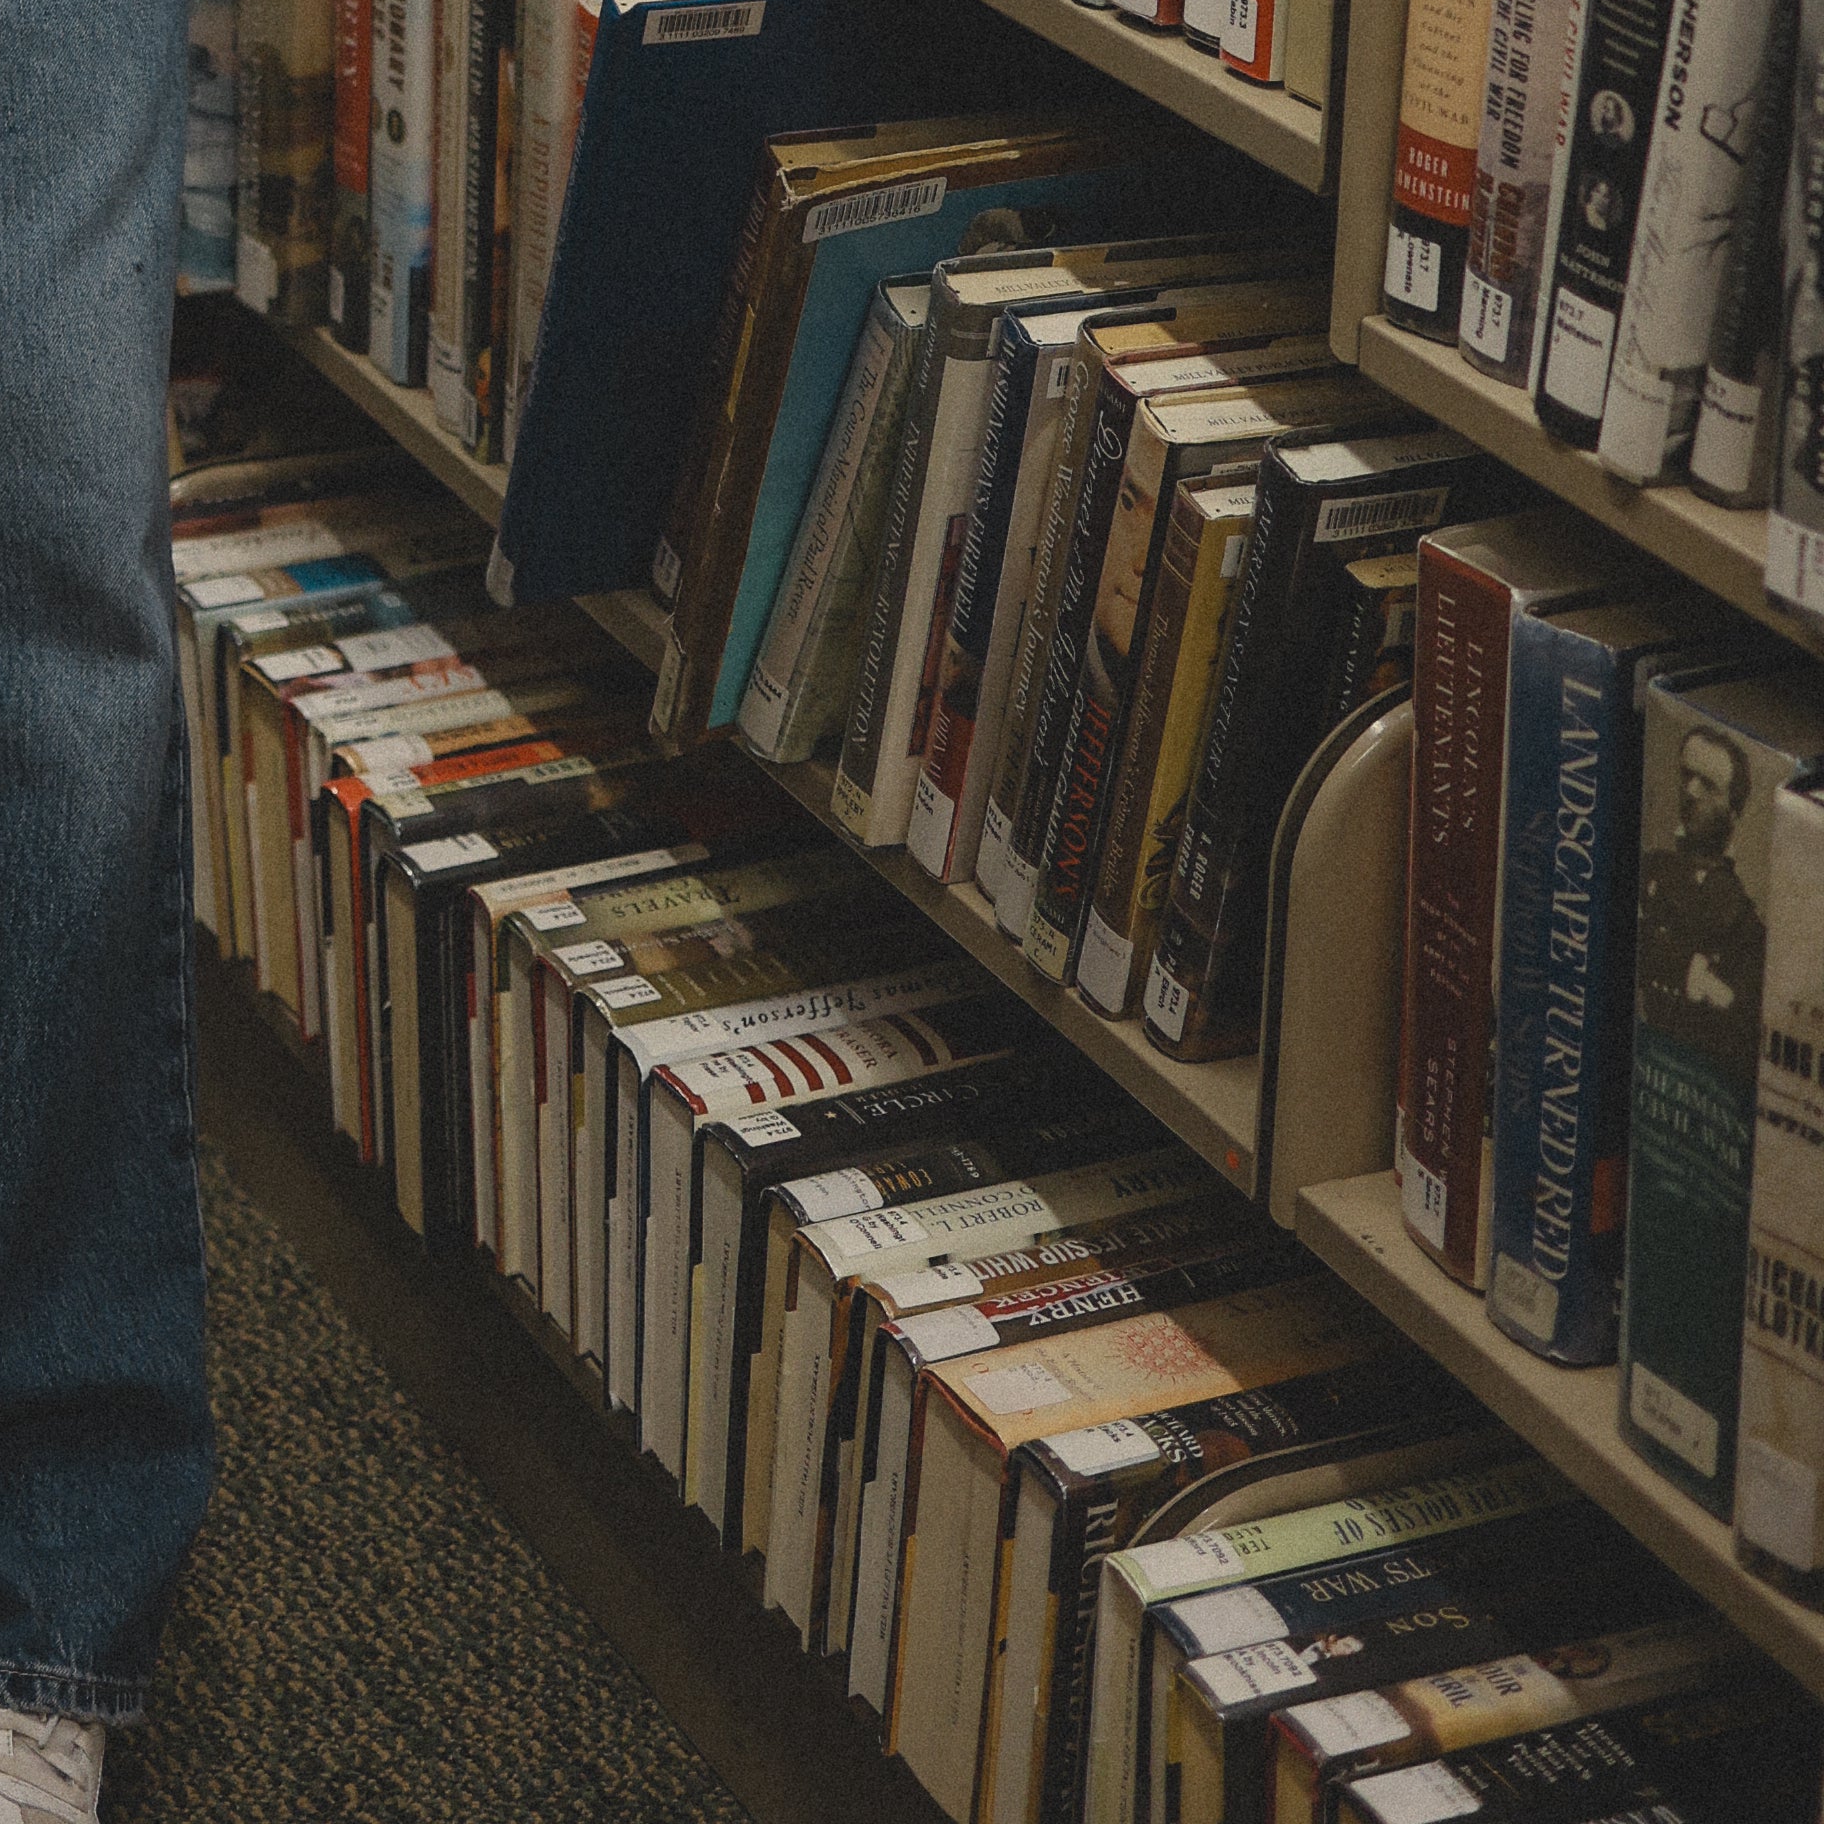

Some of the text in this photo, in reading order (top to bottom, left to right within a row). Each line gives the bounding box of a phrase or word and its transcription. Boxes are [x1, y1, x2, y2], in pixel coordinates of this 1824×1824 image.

[1500, 87, 1530, 169] FREEDOM
[1511, 52, 1534, 83] FOR
[950, 338, 1020, 634] WASHINGTON'S FAREWELL
[1014, 360, 1090, 722] George Washington's Journey
[849, 419, 922, 748] INHERITING REVOLUTION
[1431, 592, 1457, 847] LIEUTENANTS
[1460, 639, 1485, 834] LINCOLN'S
[722, 986, 868, 1038] Jefferson's
[1528, 674, 1603, 1278] LANDSCAPE TURNED RED
[1422, 1057, 1441, 1143] SEARS
[1026, 1281, 1145, 1327] HENRY
[1300, 1572, 1379, 1604] WAR
